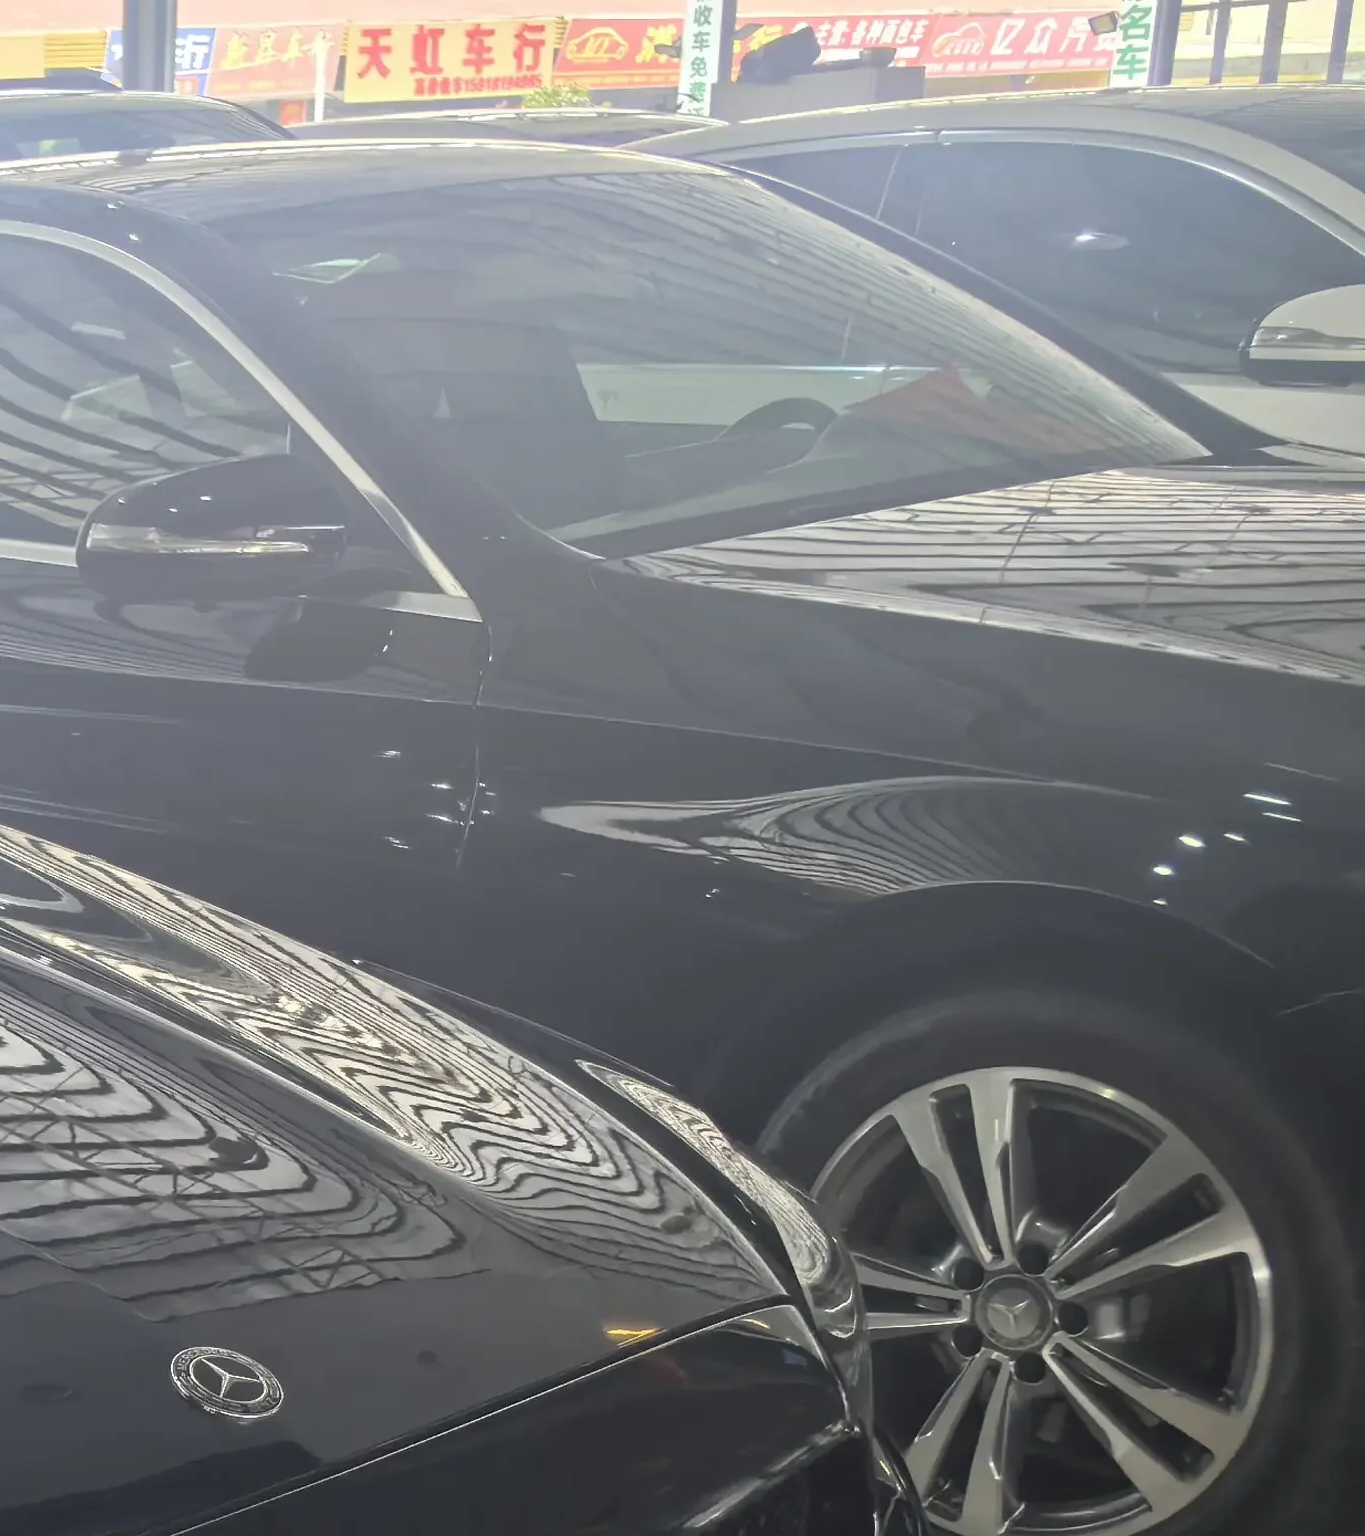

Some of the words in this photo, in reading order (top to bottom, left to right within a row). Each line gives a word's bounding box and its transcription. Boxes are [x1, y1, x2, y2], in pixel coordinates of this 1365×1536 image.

[356, 23, 547, 79] 天虹车行
[1112, 0, 1152, 80] 名车
